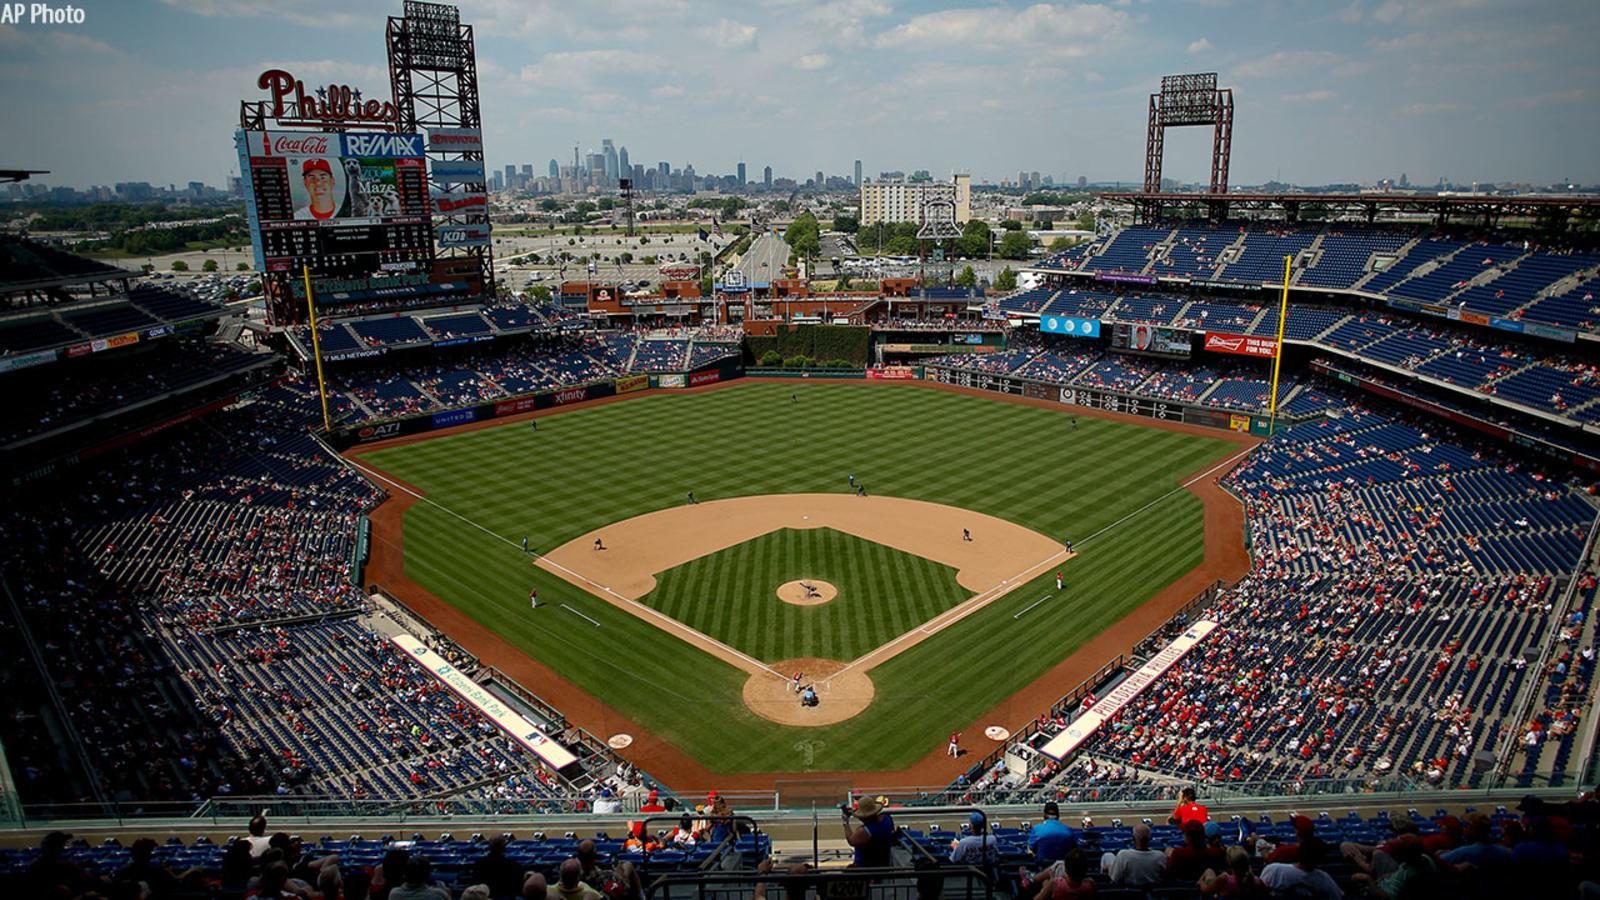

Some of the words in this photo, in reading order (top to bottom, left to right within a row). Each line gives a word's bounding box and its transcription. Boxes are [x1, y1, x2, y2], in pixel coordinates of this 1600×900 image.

[257, 69, 400, 123] Phillies
[346, 135, 418, 156] RE/MAX
[358, 181, 396, 194] Maze
[331, 353, 346, 362] MLB
[555, 389, 586, 403] xfinity
[435, 414, 465, 424] UNITED
[1092, 671, 1151, 717] PHILADELPHIA
